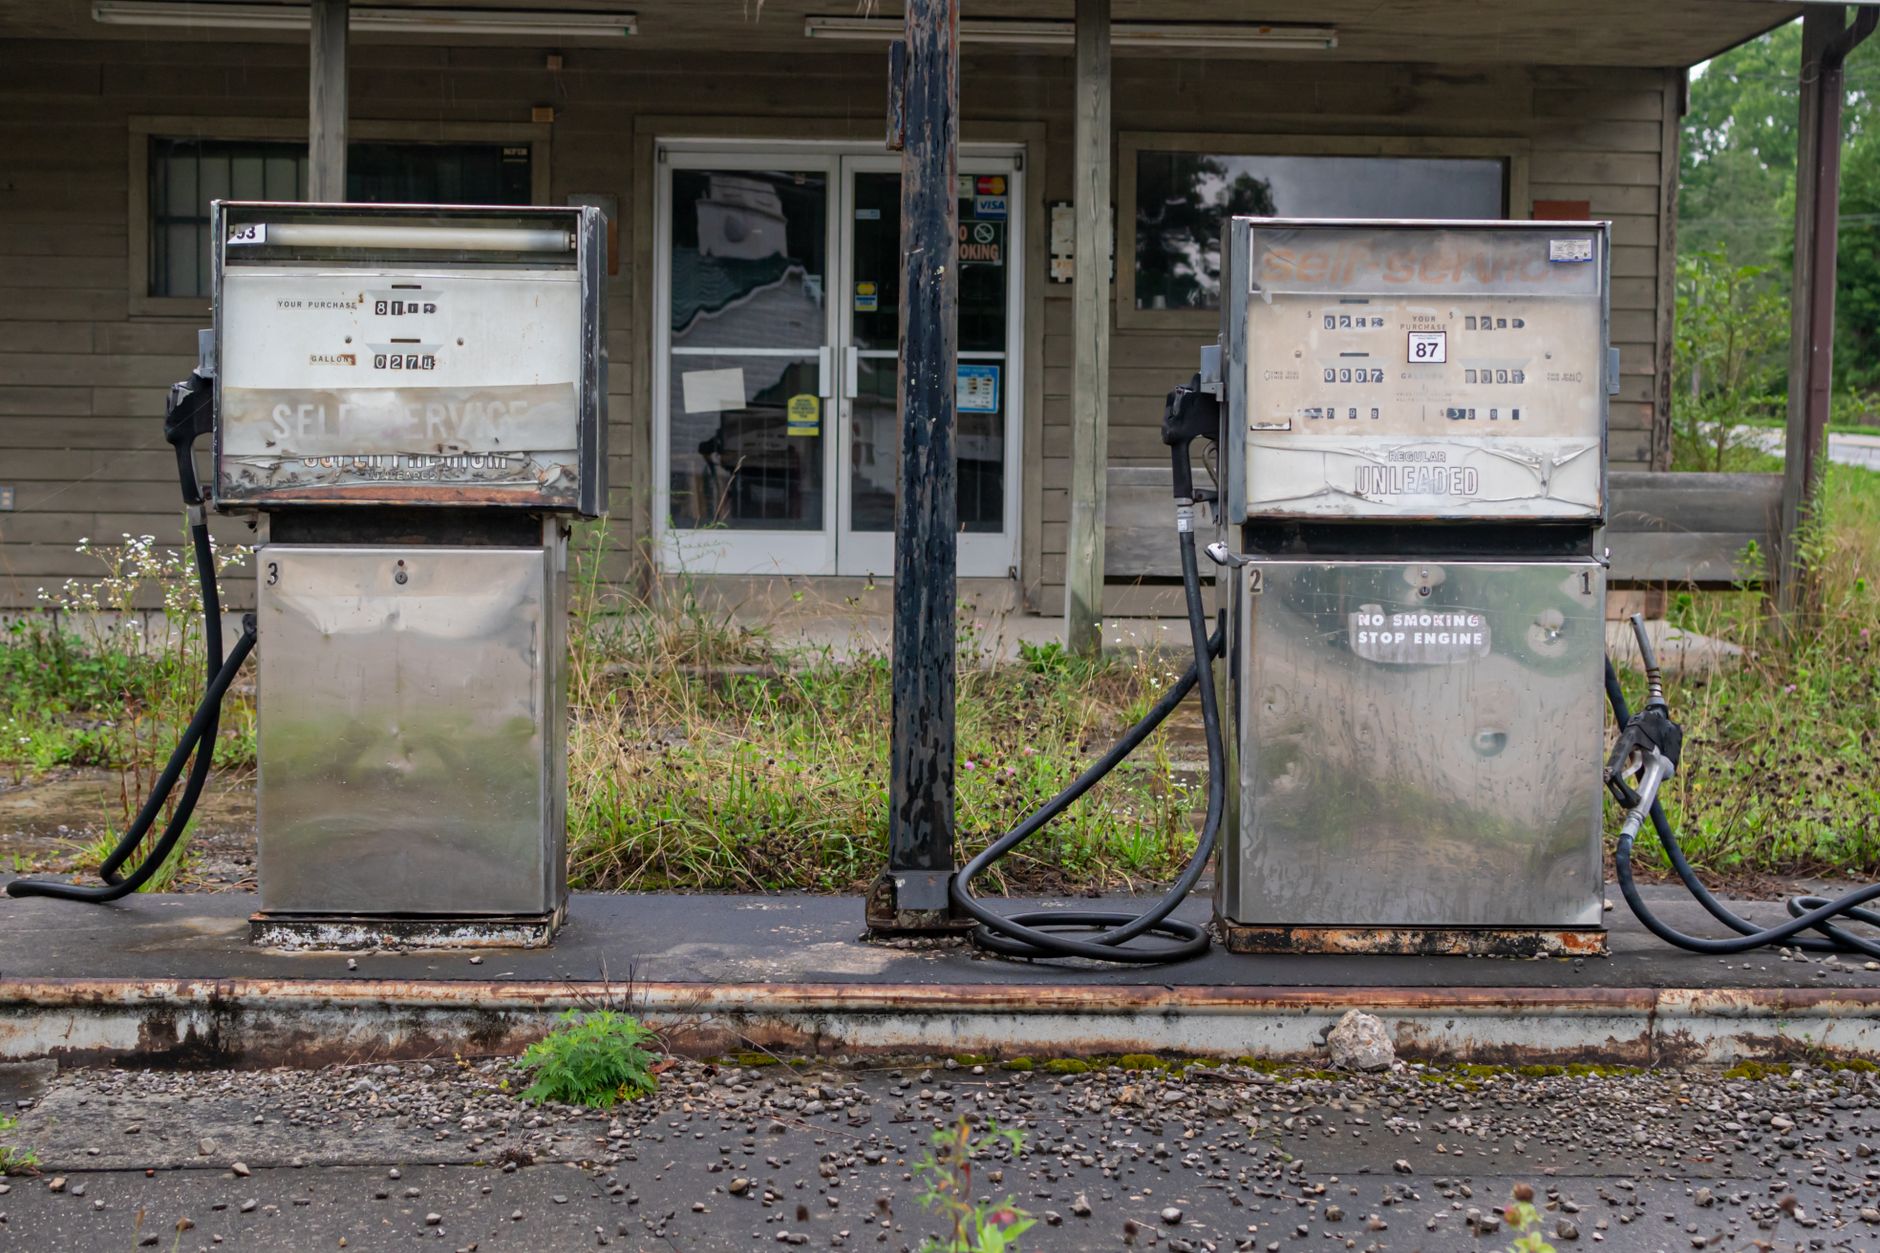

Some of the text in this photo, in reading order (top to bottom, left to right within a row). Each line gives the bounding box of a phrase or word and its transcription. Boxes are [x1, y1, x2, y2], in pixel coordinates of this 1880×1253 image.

[980, 200, 1005, 210] VISA
[958, 225, 968, 242] O
[958, 243, 999, 261] OKING
[278, 301, 357, 310] YOUR PURCHASE
[1400, 323, 1447, 331] PURCHASE
[1415, 342, 1439, 358] 87
[400, 401, 528, 440] ERVICE
[1388, 450, 1447, 463] REGULAR
[1355, 465, 1479, 496] UNLEADED
[266, 562, 279, 586] 3
[1249, 569, 1262, 593] 2
[1581, 571, 1592, 596] 1
[1358, 613, 1480, 628] NO SMOKING
[1358, 631, 1482, 645] STOP ENGINE
